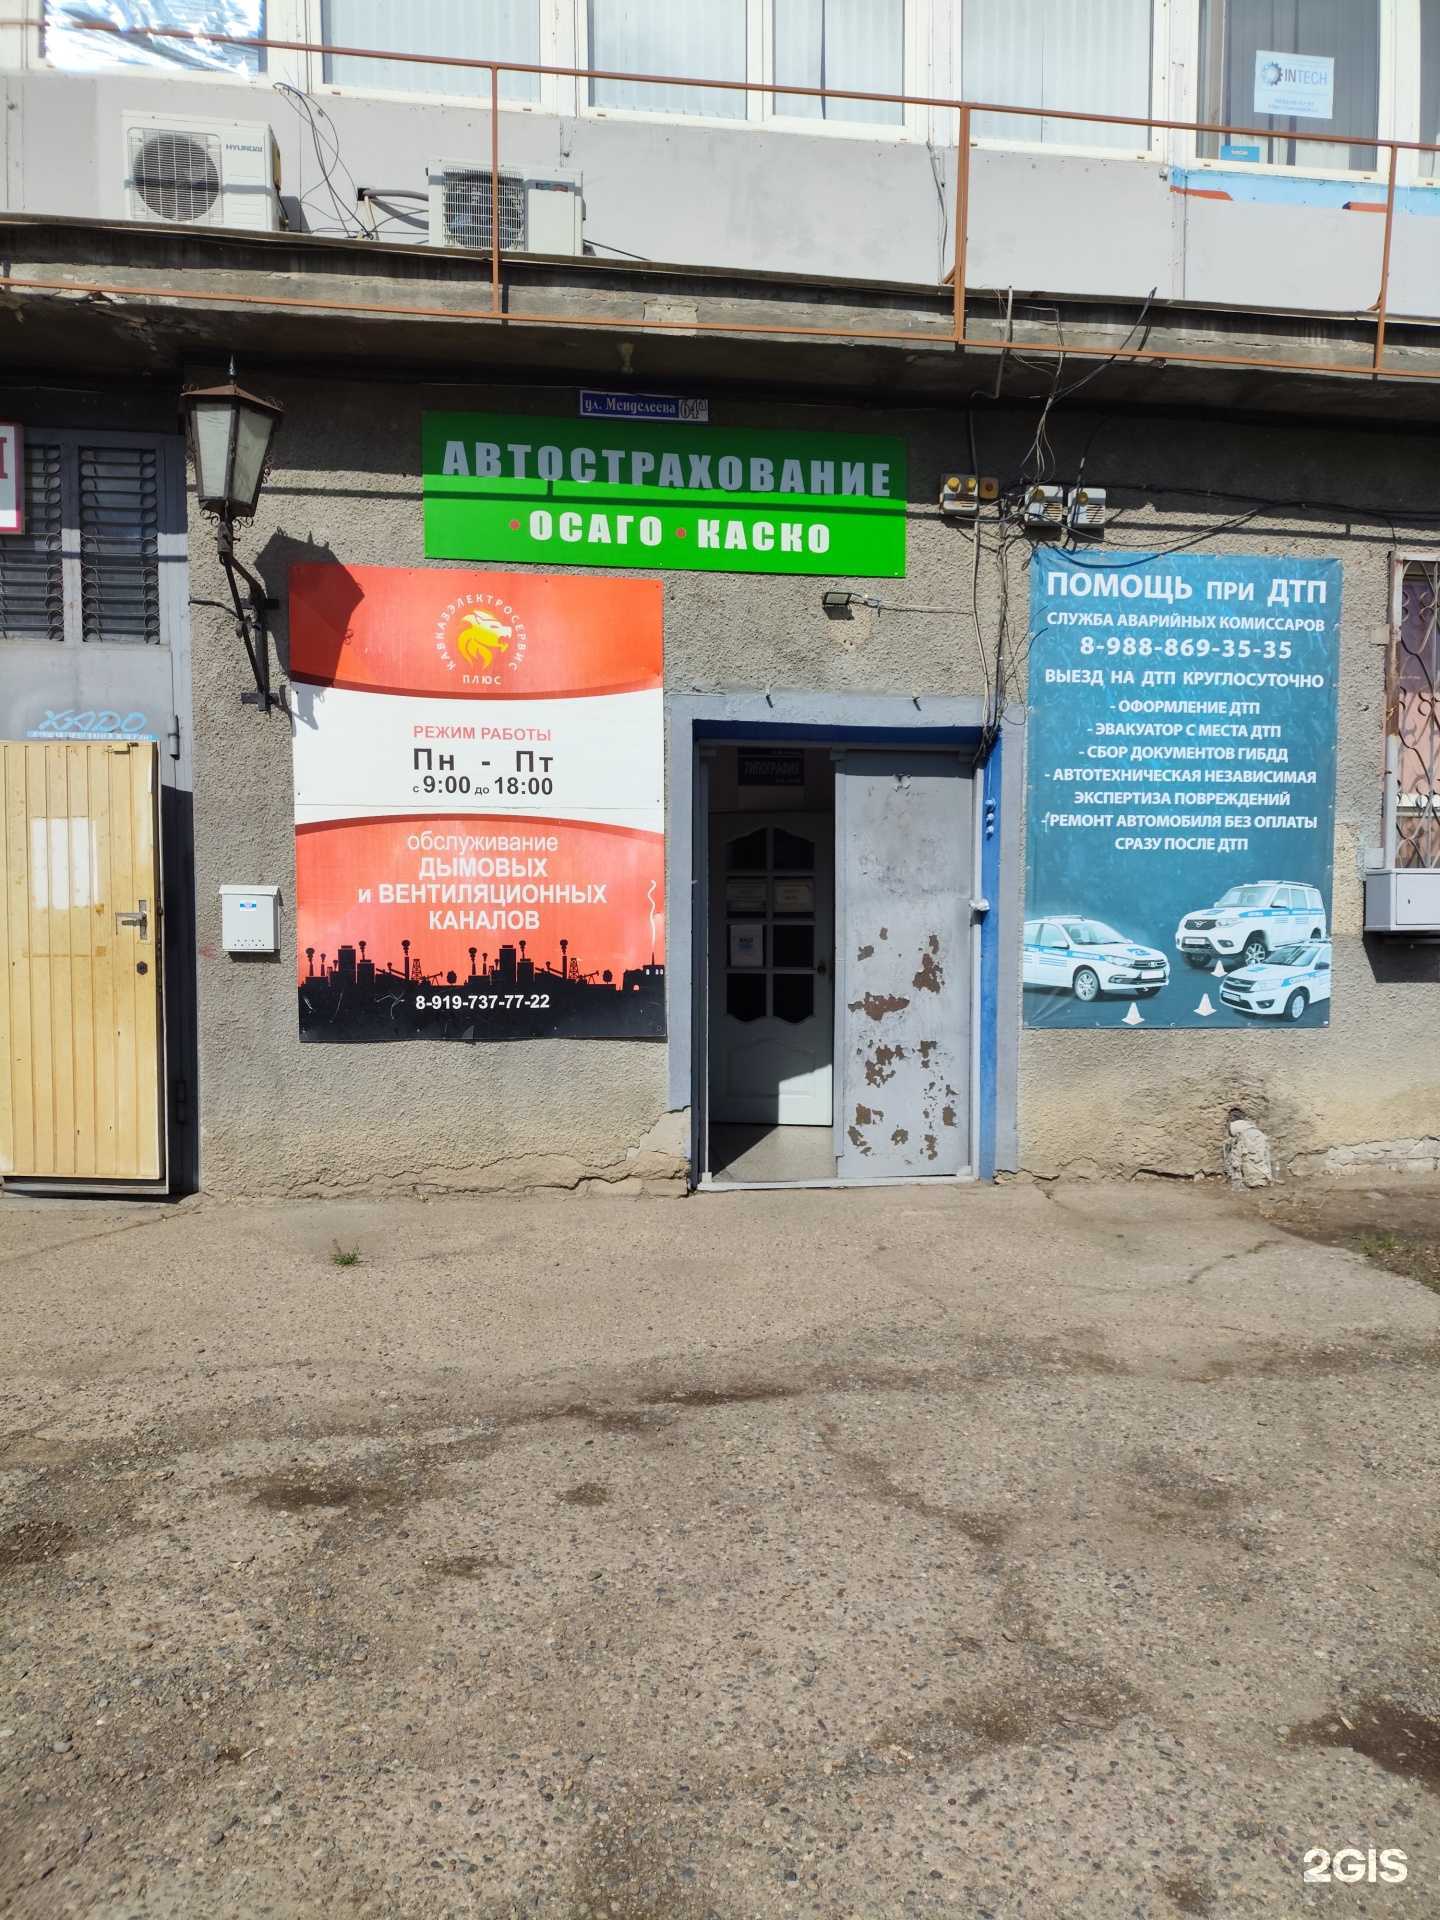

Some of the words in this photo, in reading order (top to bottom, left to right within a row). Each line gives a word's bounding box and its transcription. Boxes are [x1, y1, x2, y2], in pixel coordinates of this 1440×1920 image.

[1284, 69, 1328, 85] INTECH
[585, 398, 602, 410] ул.
[606, 397, 676, 414] Менделеева
[442, 440, 891, 497] АВТОСТРАХОВАНИЕ
[529, 510, 663, 546] ОСАГО
[697, 519, 830, 554] КАСКО
[1047, 571, 1192, 604] ПОМОЩЬ
[1206, 581, 1255, 602] ПРИ
[1267, 578, 1327, 606] ДТП
[1047, 611, 1114, 627] СЛУЖБА
[1117, 610, 1216, 629] АВАРИЙНЫХ
[1219, 614, 1326, 633] КОМИССАРОВ
[1080, 636, 1292, 660] 8-988-869-35-35
[463, 674, 502, 685] ПЛЮС
[1045, 669, 1104, 687] ВЫЕЗД
[1110, 669, 1135, 685] НА
[1141, 671, 1176, 688] ДТП
[1182, 671, 1325, 689] КРУГЛОСУТОЧНО
[1118, 699, 1227, 714] ОФОРМЛЕНИЕ
[1229, 700, 1261, 717] ДТП
[413, 725, 476, 739] РЕЖИМ
[481, 727, 551, 742] РАБОТЫ
[1095, 722, 1183, 737] ЭВАКУАТОР
[1185, 723, 1195, 737] С
[1199, 723, 1248, 738] МЕСТА
[1250, 724, 1281, 740] ДТП
[413, 748, 455, 771] Пн
[515, 750, 553, 773] Пт
[1087, 745, 1127, 760] СБОР
[1130, 745, 1235, 761] ДОКУМЕНТОВ
[1238, 746, 1289, 763] ГИБДД
[423, 776, 471, 794] 9:00
[475, 785, 490, 796] до
[494, 777, 553, 796] 18:00
[1053, 768, 1202, 784] АВТОТЕХНИЧЕСКАЯ
[1204, 769, 1317, 785] НЕЗАВИСИМАЯ
[1074, 790, 1171, 806] ЭКСПЕРТИЗА
[1174, 790, 1291, 808] ПОВРЕЖДЕНИЙ
[1050, 814, 1114, 829] РЕМОНТ
[1116, 814, 1221, 830] АВТОМОБИЛЯ
[1224, 815, 1252, 830] БЕЗ
[1254, 814, 1318, 830] ОПЛАТЫ
[407, 831, 559, 855] обслуживание
[1115, 837, 1162, 852] СРАЗУ
[1164, 837, 1215, 852] ПОСЛЕ
[1217, 838, 1248, 854] ДТП
[419, 857, 547, 879] ДЫМОВЫХ
[358, 889, 371, 903] и
[379, 883, 607, 907] ВЕНТИЛЯЦИОННЫХ
[428, 909, 540, 931] КАНАЛОВ
[415, 993, 551, 1011] 8-919-737-77-22
